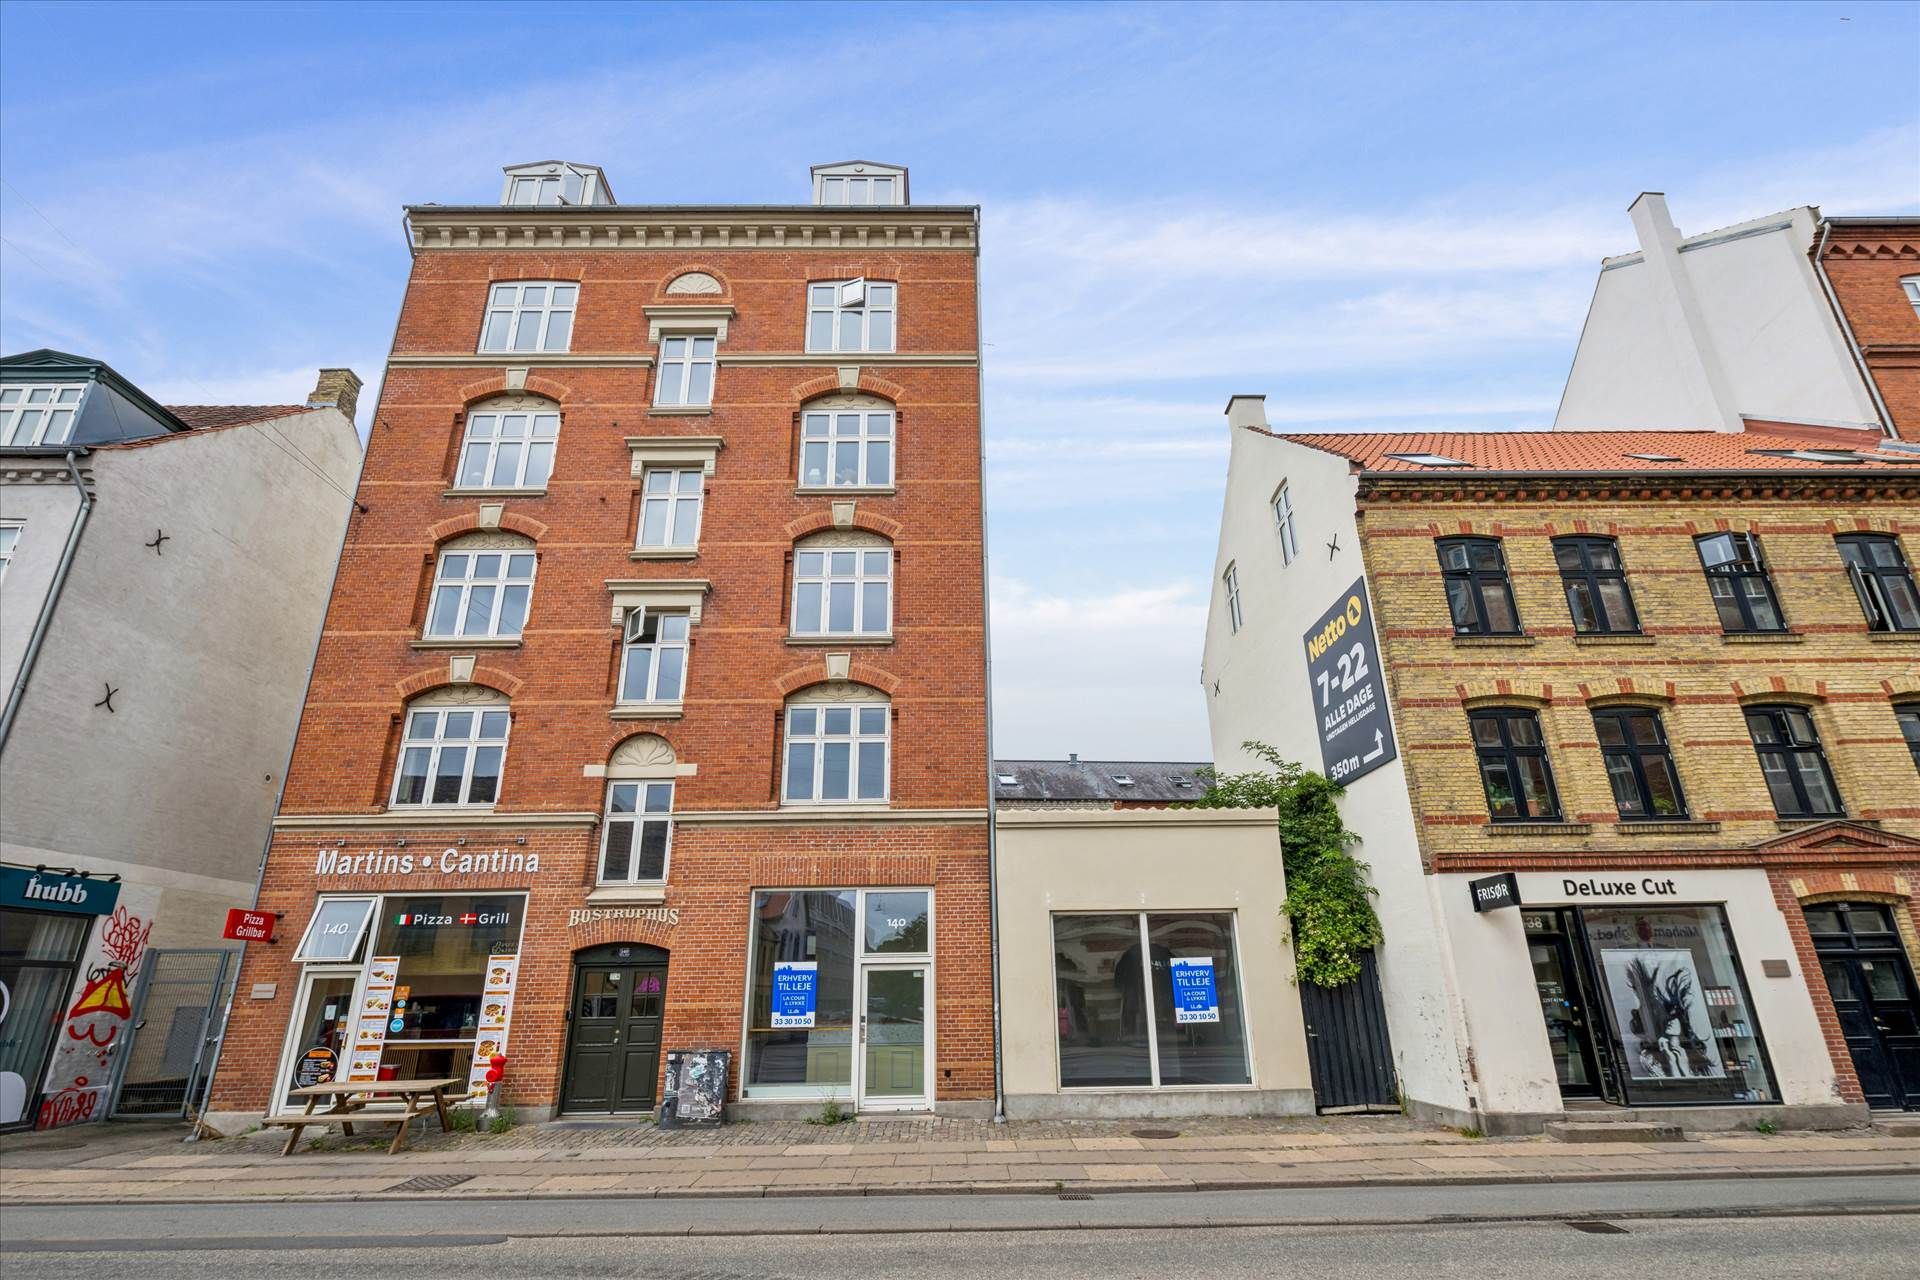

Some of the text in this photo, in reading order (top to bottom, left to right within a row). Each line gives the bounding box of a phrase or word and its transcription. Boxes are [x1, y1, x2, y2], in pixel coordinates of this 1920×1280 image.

[1308, 615, 1346, 663] Netto
[1317, 642, 1369, 708] 7-22
[1325, 683, 1374, 731] ALLE DAGE
[315, 848, 540, 875] Martins Cantina
[24, 877, 88, 904] hubb
[1477, 884, 1509, 901] FRISØR
[1563, 878, 1677, 896] DeLuxe Cut
[243, 913, 265, 926] Pizza
[413, 912, 510, 926] Pizza Grill
[568, 907, 680, 927] BOSTRUPHUS
[887, 918, 906, 929] 140
[236, 925, 266, 938] Grillbar
[323, 922, 349, 935] 140
[1175, 970, 1210, 978] ERHVERV
[792, 982, 812, 990] LEJE
[1177, 978, 1211, 987] TIL LEJE
